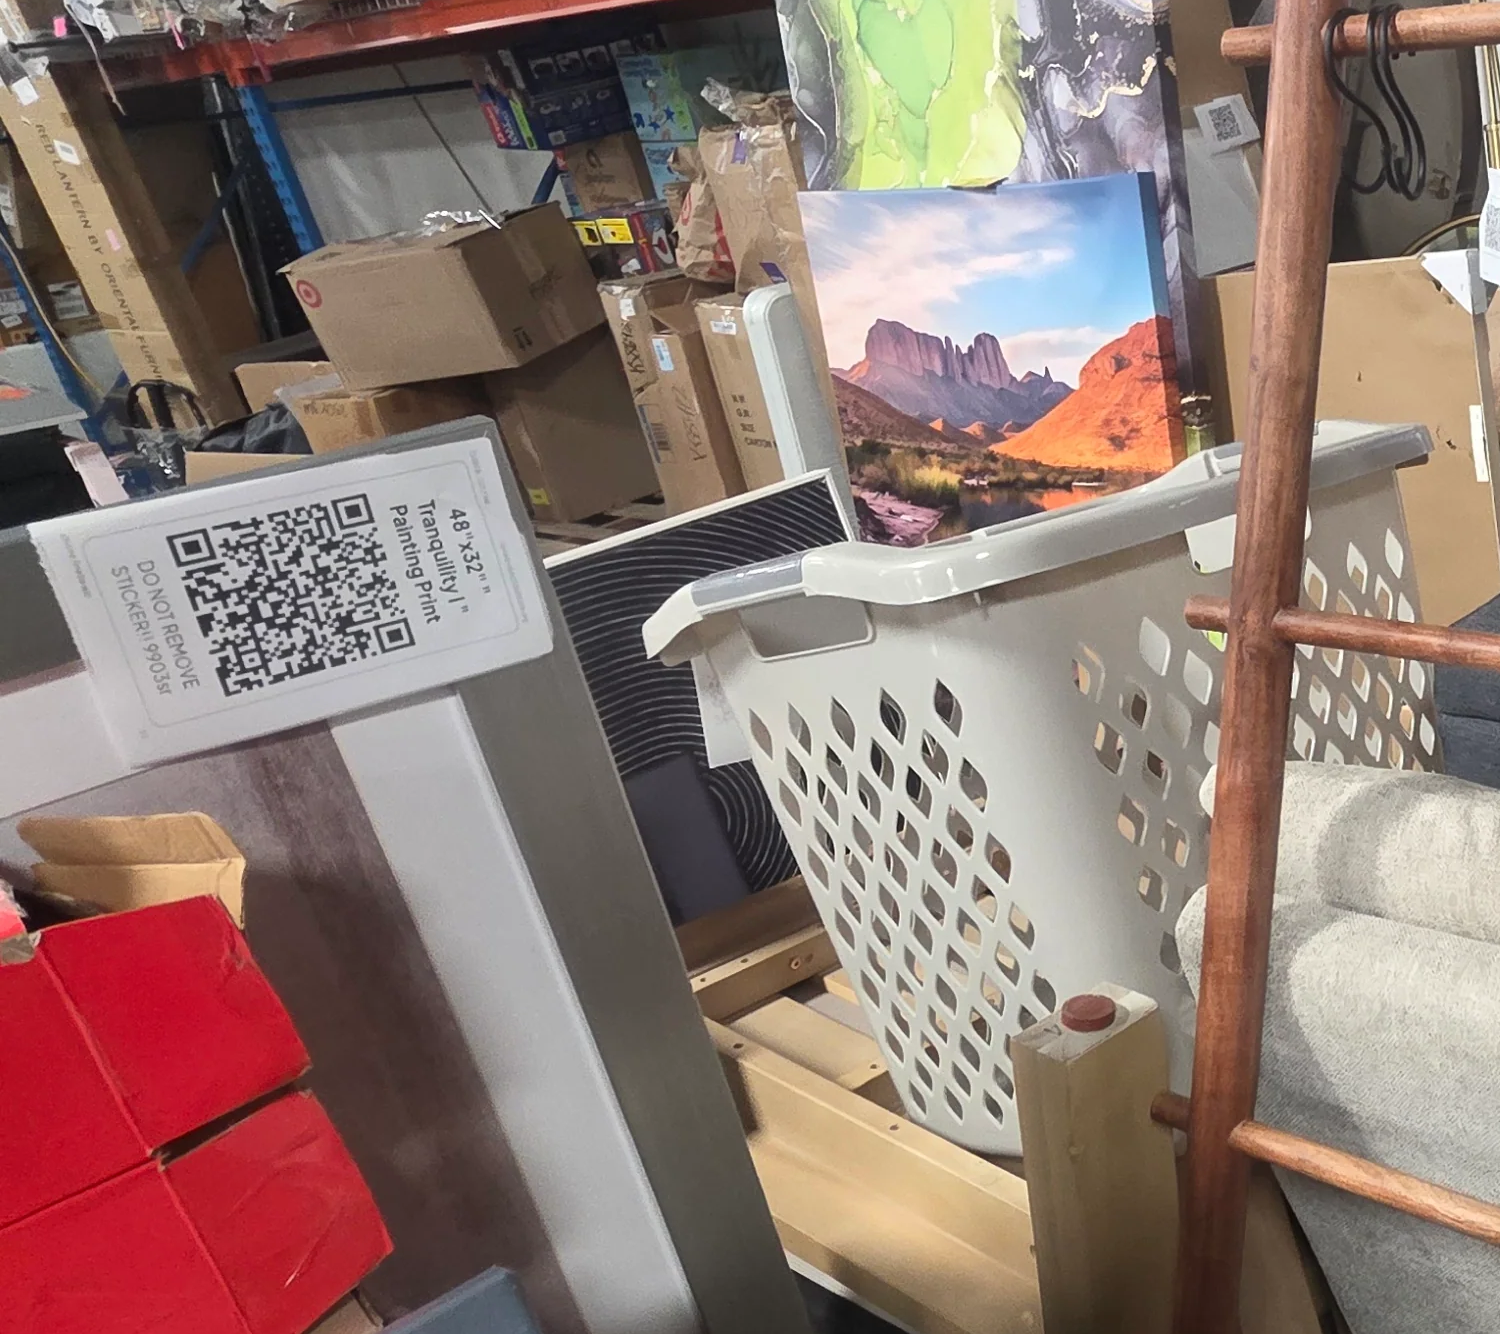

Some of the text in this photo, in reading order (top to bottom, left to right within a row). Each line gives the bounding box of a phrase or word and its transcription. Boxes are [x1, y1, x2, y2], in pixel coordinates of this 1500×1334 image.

[34, 123, 164, 381] RED LANTERN BY ORIENTAL FURNI
[389, 503, 441, 625] Painting Print
[417, 498, 459, 594] Tranquility
[136, 560, 201, 690] DO NOT REMOVE
